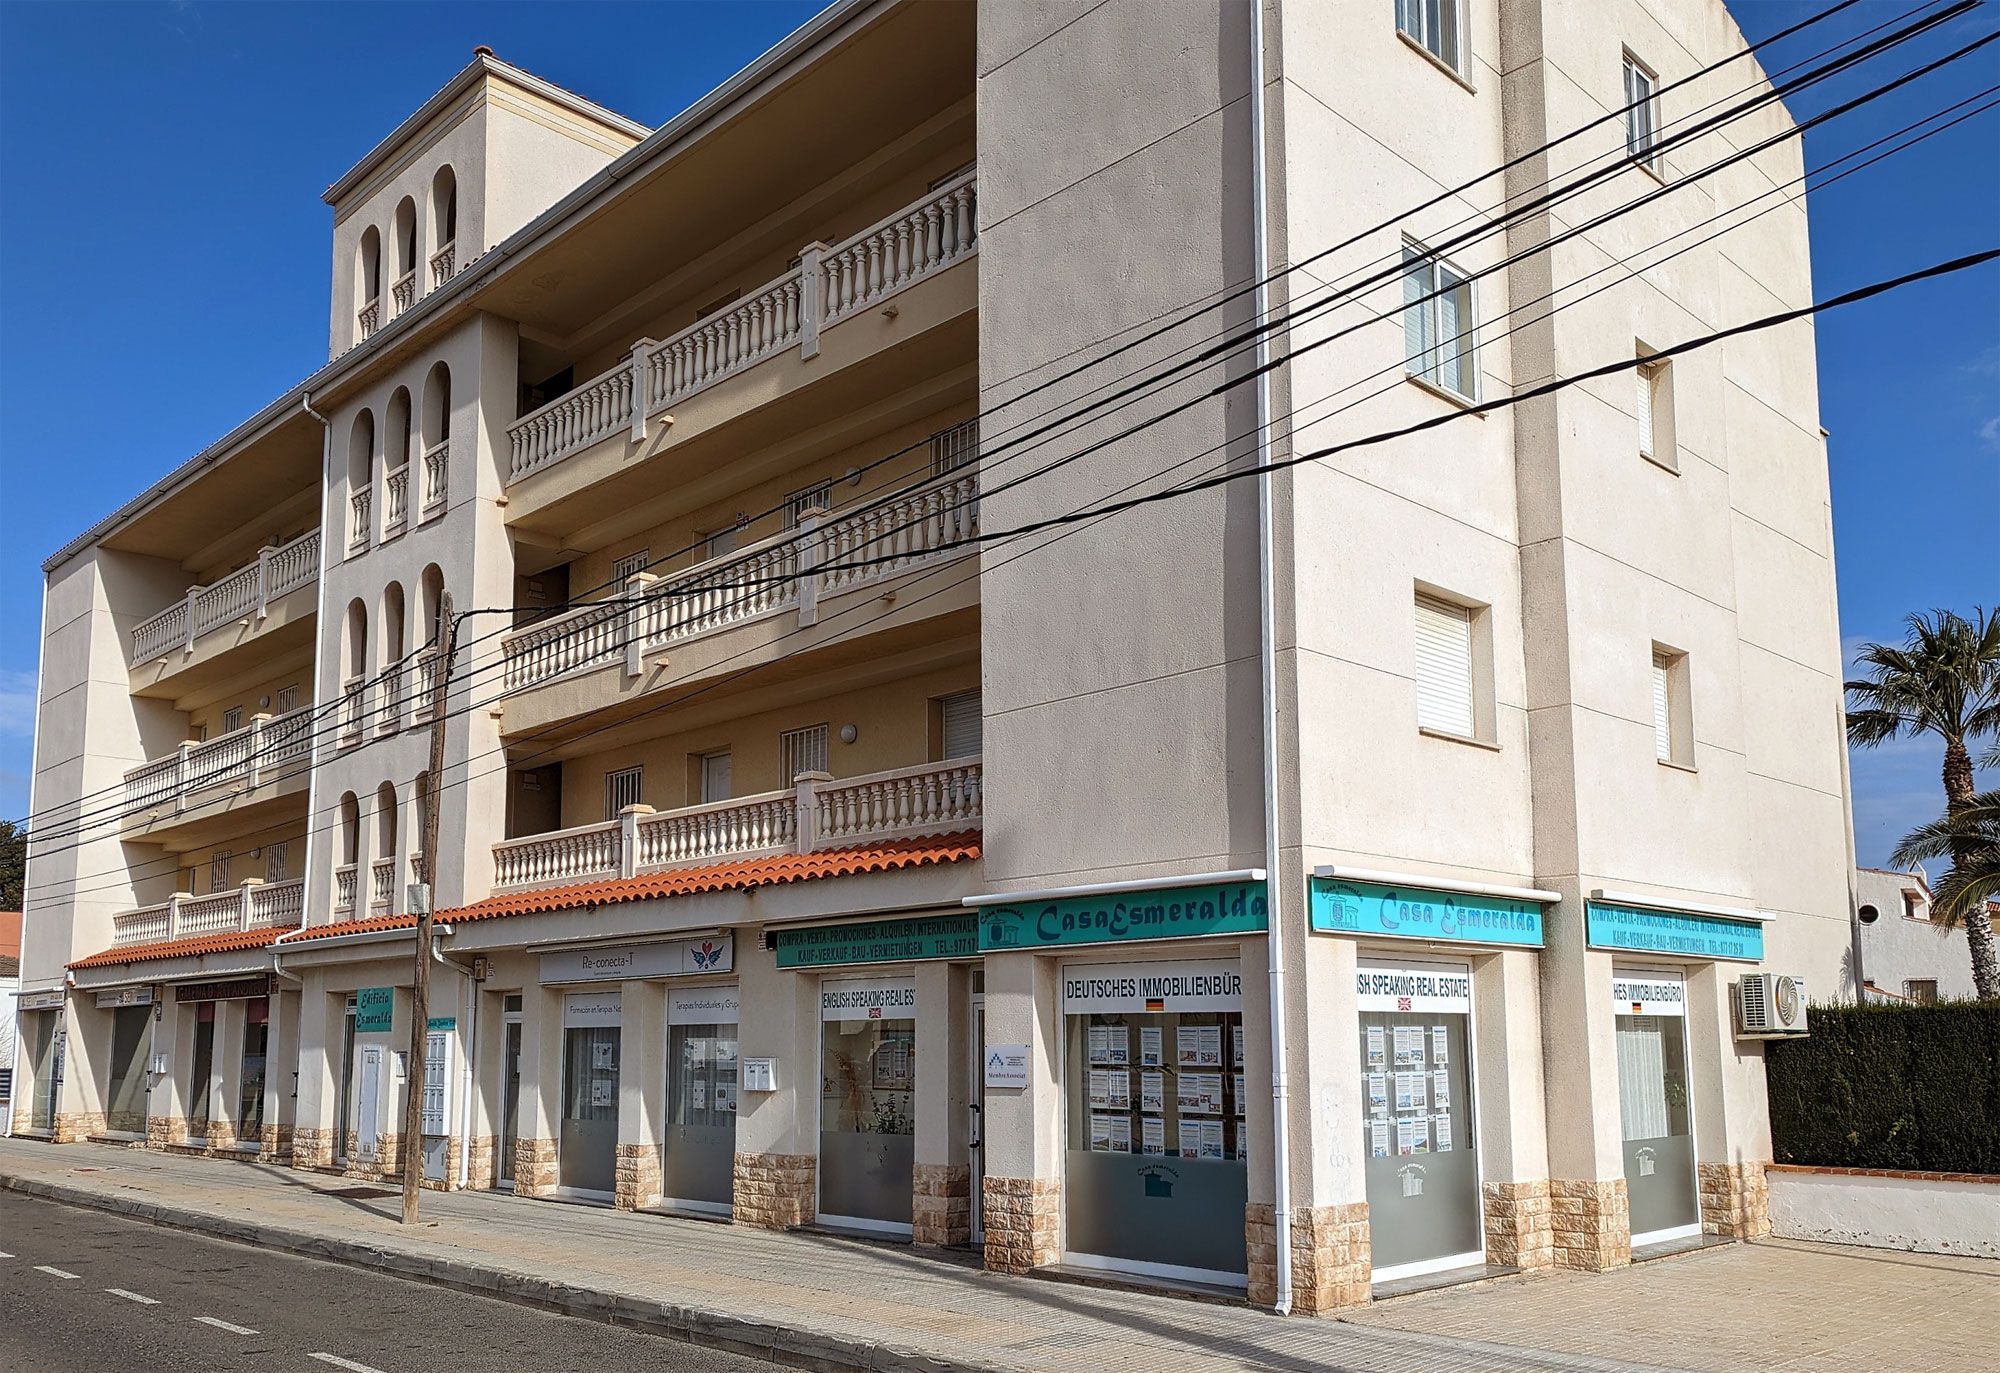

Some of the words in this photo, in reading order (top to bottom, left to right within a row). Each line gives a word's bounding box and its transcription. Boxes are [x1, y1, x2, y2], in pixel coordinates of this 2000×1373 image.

[1037, 906, 1108, 941] Casa
[1109, 888, 1268, 936] Esmeralda
[1380, 891, 1433, 929] Casa
[1441, 898, 1535, 935] Esmeralda
[583, 952, 634, 969] Re-conecta-T
[1067, 979, 1135, 999] DEUTSCHES
[1139, 972, 1241, 997] IMMOBILIENBÜR
[1372, 974, 1414, 996] SPEAKING
[1417, 977, 1437, 997] REAL
[1439, 978, 1467, 998] ESTATE
[1628, 982, 1681, 1002] IMMOBILIENBÜRO
[361, 991, 388, 1008] Edificio
[823, 992, 850, 1008] ENGLISH
[852, 990, 884, 1007] SPEAKING
[886, 989, 903, 1006] REAL
[356, 1012, 391, 1028] Esmeralda
